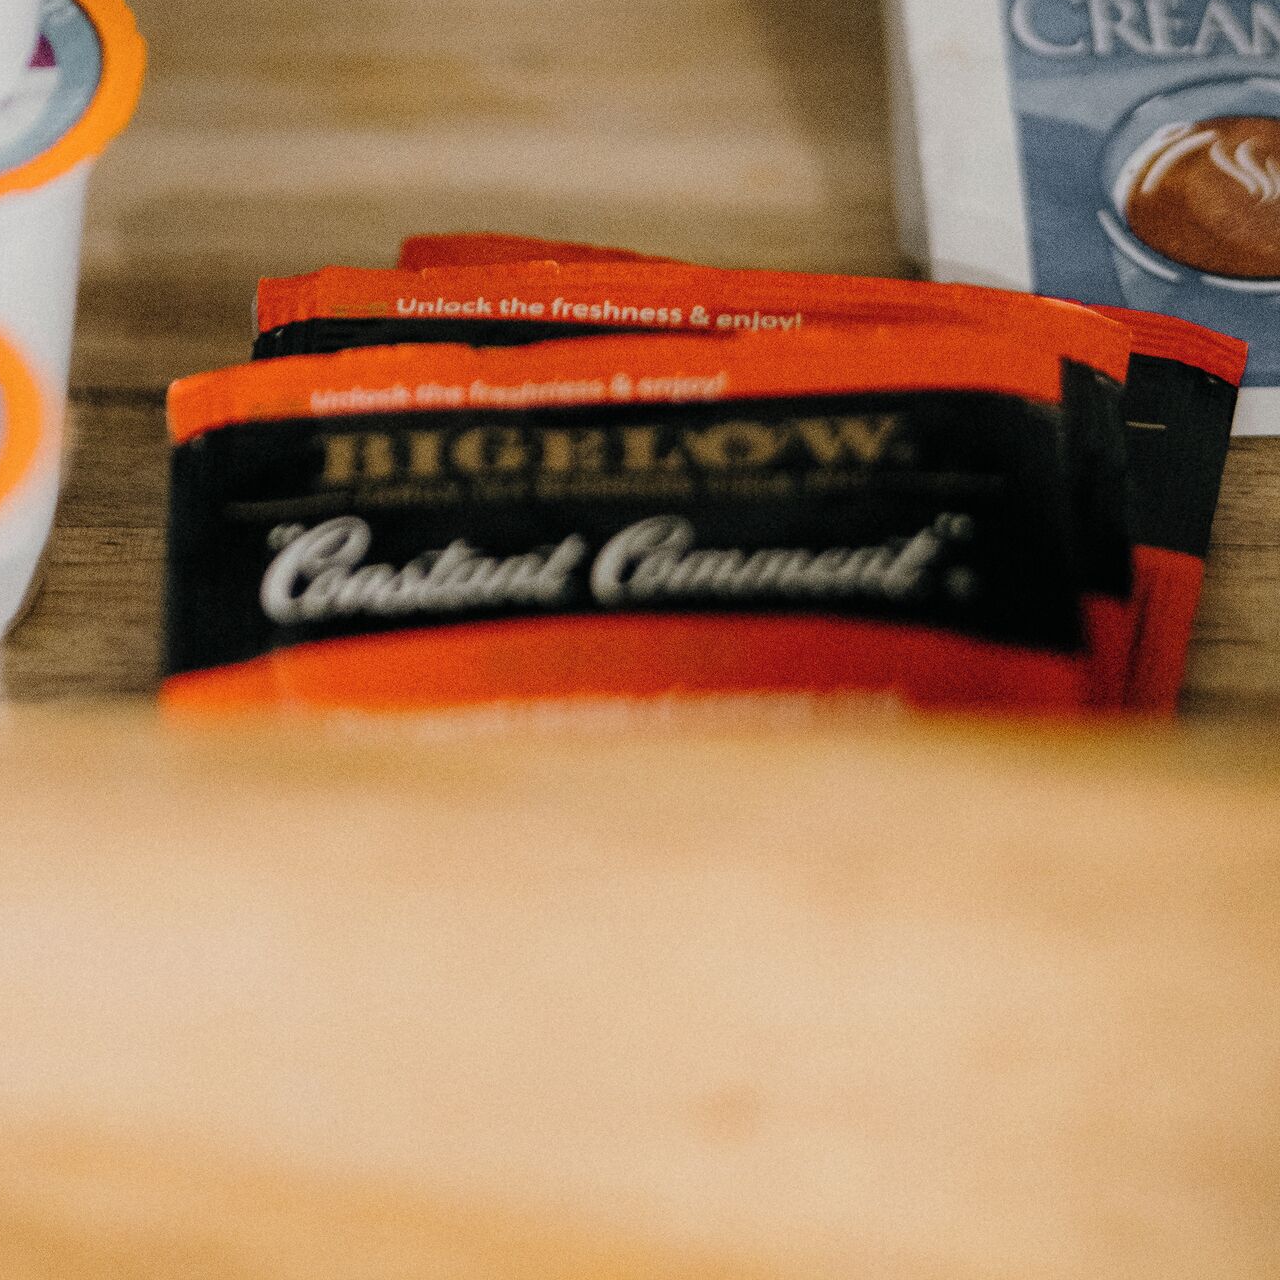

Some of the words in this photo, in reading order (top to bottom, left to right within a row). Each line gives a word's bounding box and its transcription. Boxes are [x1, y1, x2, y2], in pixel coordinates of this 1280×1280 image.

[396, 297, 492, 315] Unlock
[499, 298, 545, 316] the
[551, 297, 683, 324] freshness
[689, 304, 710, 326] &
[716, 311, 802, 332] enjoy!
[323, 414, 898, 481] BIGELOW
